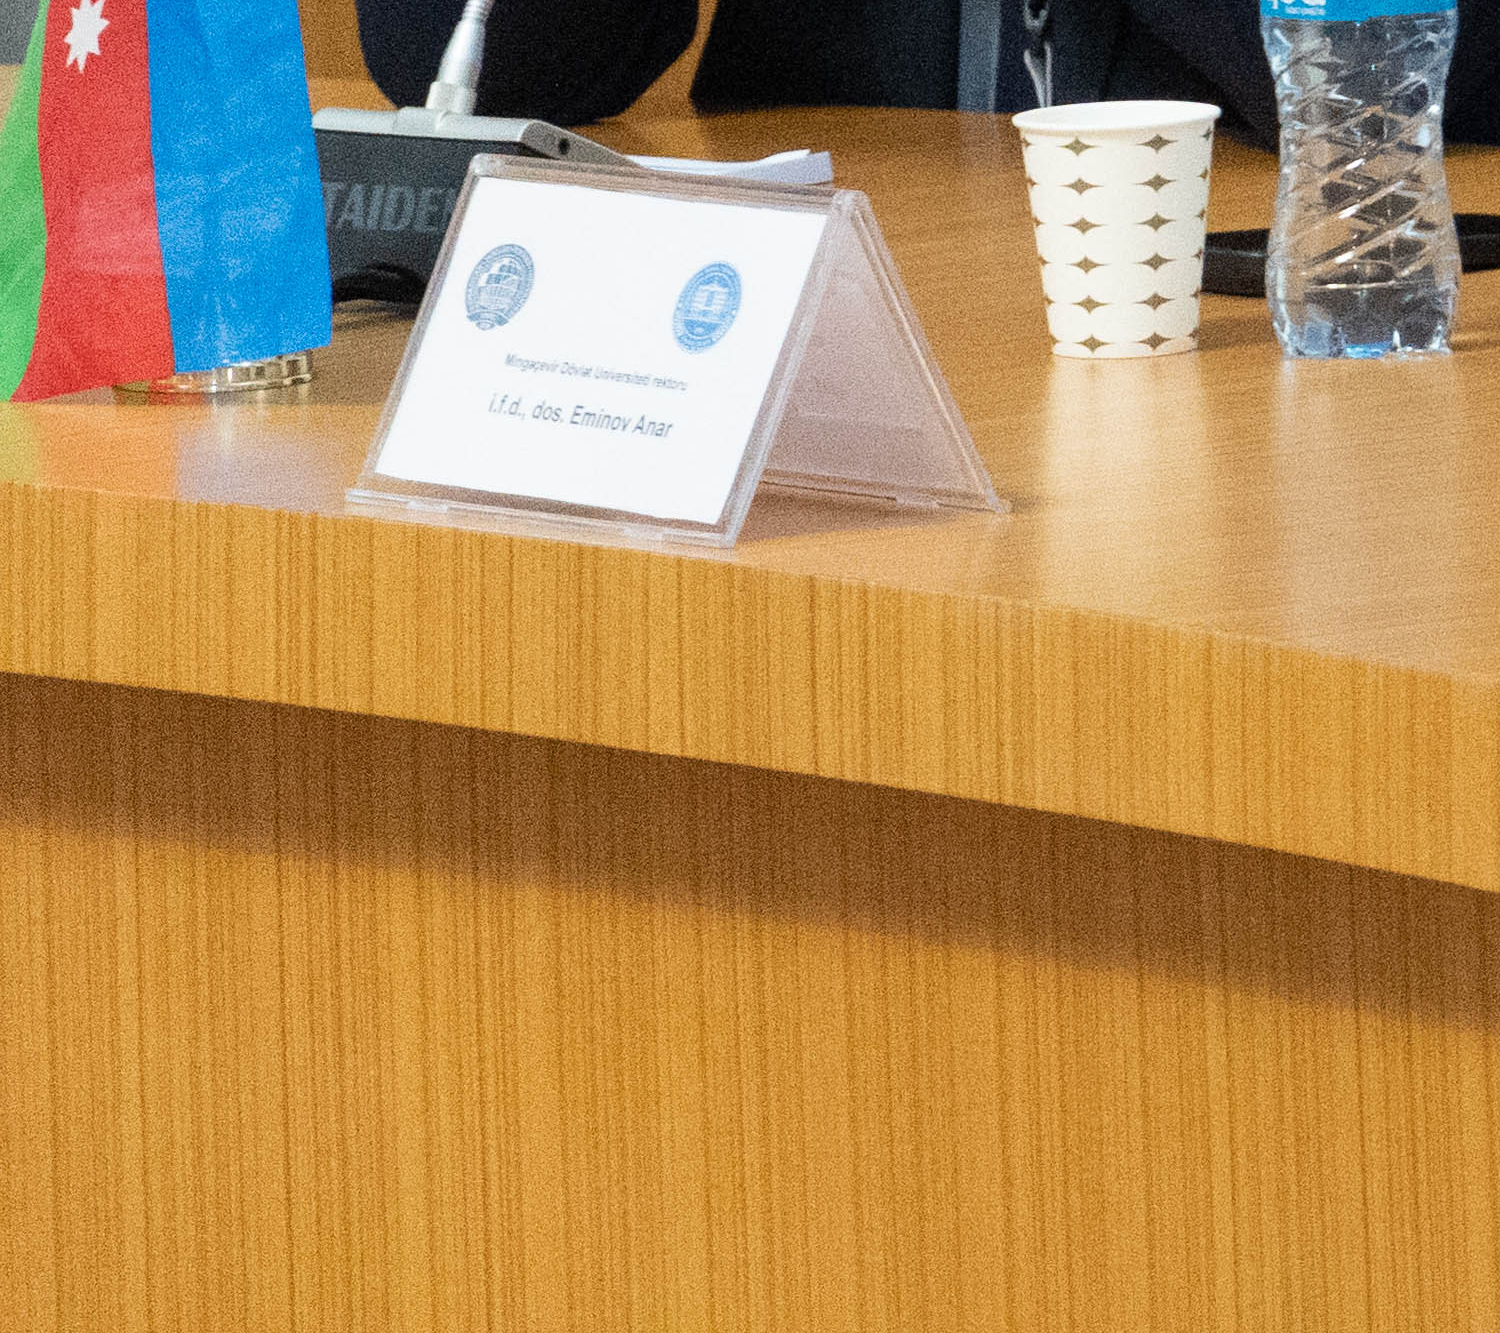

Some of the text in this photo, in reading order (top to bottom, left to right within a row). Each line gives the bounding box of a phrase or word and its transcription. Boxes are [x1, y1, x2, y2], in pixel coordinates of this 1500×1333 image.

[532, 399, 565, 423] dos.
[569, 404, 630, 432] Eminov
[632, 413, 674, 438] Anar
